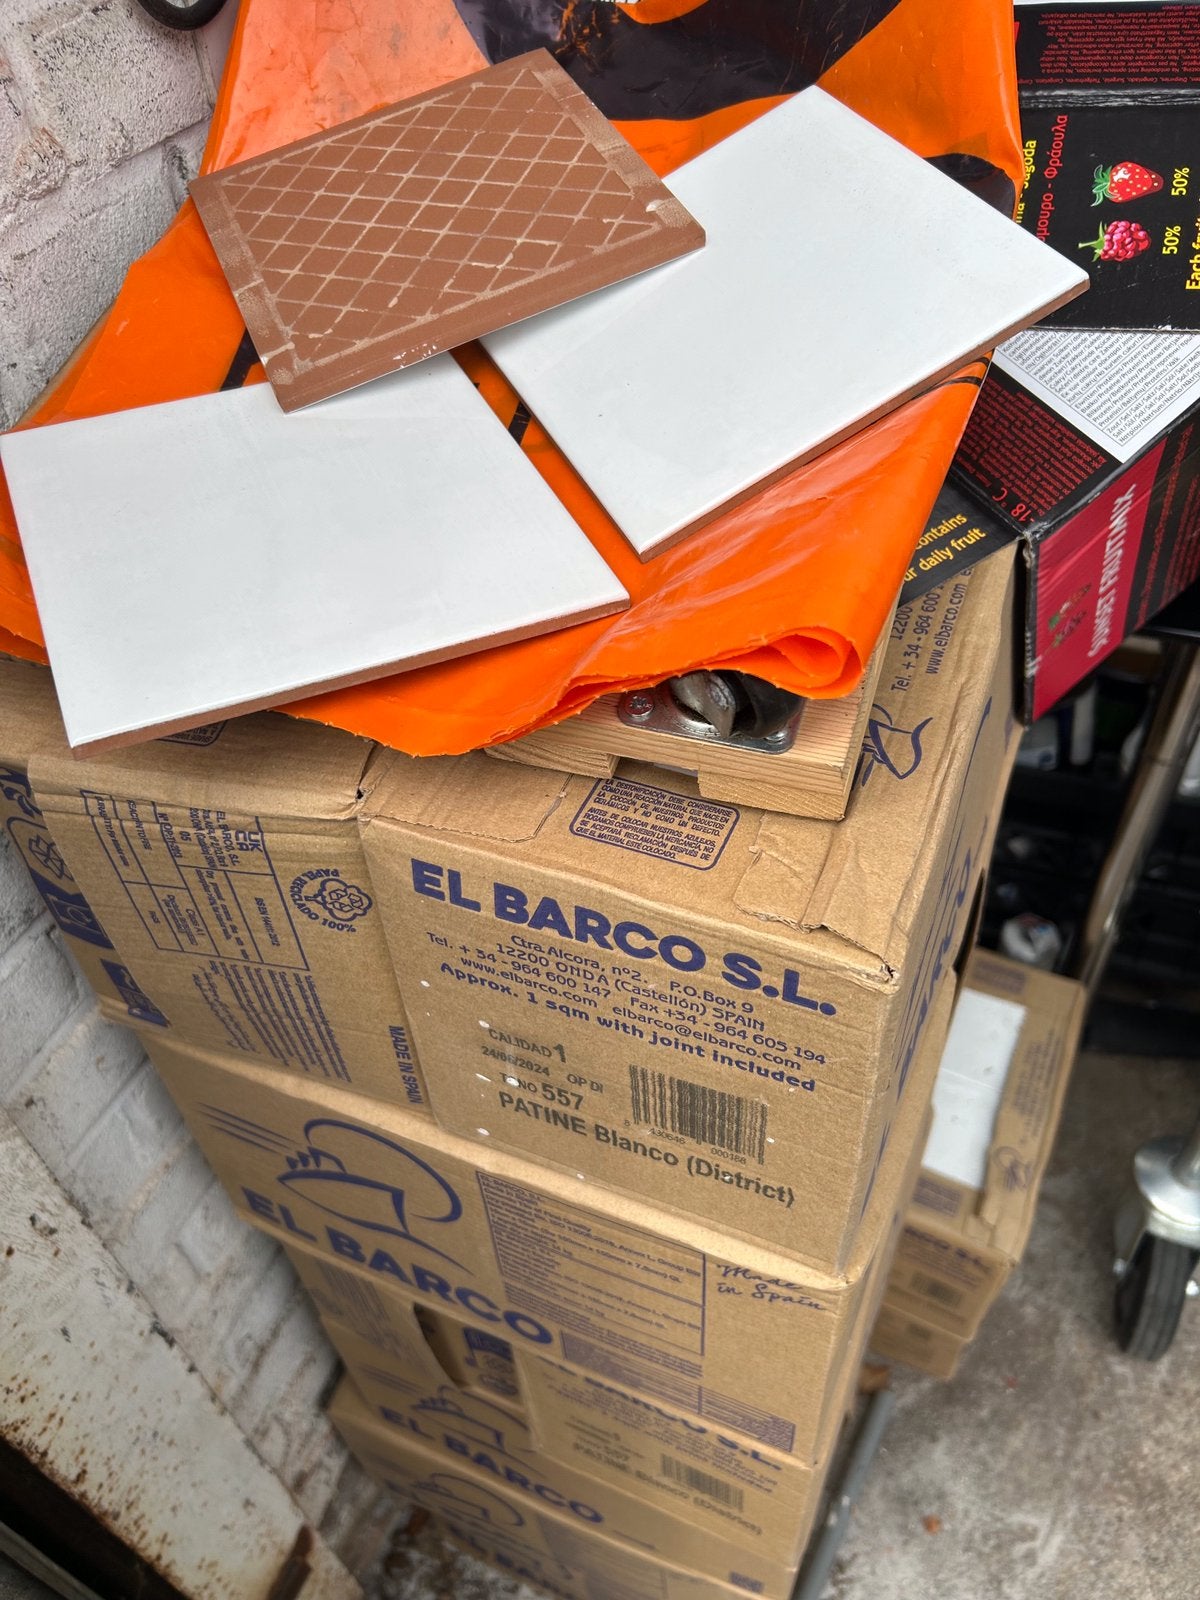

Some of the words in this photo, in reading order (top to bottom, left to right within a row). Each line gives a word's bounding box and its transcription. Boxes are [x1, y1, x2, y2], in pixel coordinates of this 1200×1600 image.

[1044, 115, 1068, 178] Φράουλα
[1171, 167, 1190, 196] 50%
[1163, 226, 1181, 254] 50%
[919, 547, 953, 571] daily
[951, 528, 986, 551] fruit
[922, 593, 940, 612] 600
[891, 607, 912, 640] 12200
[913, 615, 932, 635] 964
[926, 583, 967, 674] www.elbarco.com
[904, 644, 922, 659] 34
[891, 676, 912, 692] Tel.
[584, 813, 615, 827] ROGAMOS
[588, 807, 607, 816] ANTES
[621, 816, 648, 828] COLOCAR
[662, 801, 688, 813] NATURAL
[688, 801, 733, 816] CONSIDERARSE
[178, 831, 192, 841] 05
[576, 827, 588, 835] QUE
[598, 833, 625, 845] MATERIAL
[688, 815, 725, 829] PRODUCTOS
[691, 823, 720, 836] DEFECTO.
[301, 869, 340, 880] PAPEL
[322, 918, 356, 932] 100%
[411, 858, 481, 913] EL
[493, 882, 707, 972] BARCO
[722, 952, 837, 1017] S.L.
[496, 943, 549, 968] 12200
[615, 979, 707, 1016] (Castellón)
[712, 1007, 765, 1032] SPAIN
[511, 935, 545, 953] Ctra
[548, 946, 606, 972] Alcora,
[742, 1002, 754, 1014] 9
[427, 931, 453, 949] Tel.
[476, 948, 497, 963] 34
[511, 961, 541, 978] 964
[545, 971, 577, 989] 600
[583, 982, 611, 999] 147
[630, 996, 659, 1014] Fax
[714, 1022, 749, 1040] 964
[752, 1033, 788, 1052] 605
[794, 1046, 826, 1065] 194
[440, 962, 519, 999] Approx.
[526, 991, 539, 1005] 1
[545, 999, 590, 1021] sqm
[597, 1015, 644, 1039] with
[648, 1031, 706, 1058] joint
[712, 1049, 816, 1092] included
[461, 957, 598, 1008] www.elbarco.com
[612, 1005, 801, 1071] elbarco@elbarco.com
[389, 1025, 412, 1060] MADE
[488, 1028, 552, 1058] CALIDAD
[553, 1043, 567, 1063] 1
[398, 1061, 414, 1073] IN
[402, 1075, 424, 1104] SPAIN
[541, 1082, 584, 1110] 557
[624, 1119, 632, 1127] 8
[499, 1091, 587, 1137] PATINE
[594, 1123, 680, 1166] Blanco
[687, 1155, 795, 1209] (District)
[241, 1186, 317, 1243] EL
[325, 1225, 554, 1344] BARCO
[717, 1264, 803, 1290] Made
[717, 1282, 742, 1295] in
[751, 1283, 827, 1311] Spain
[379, 1405, 436, 1442] EL
[444, 1433, 605, 1524] BARCO
